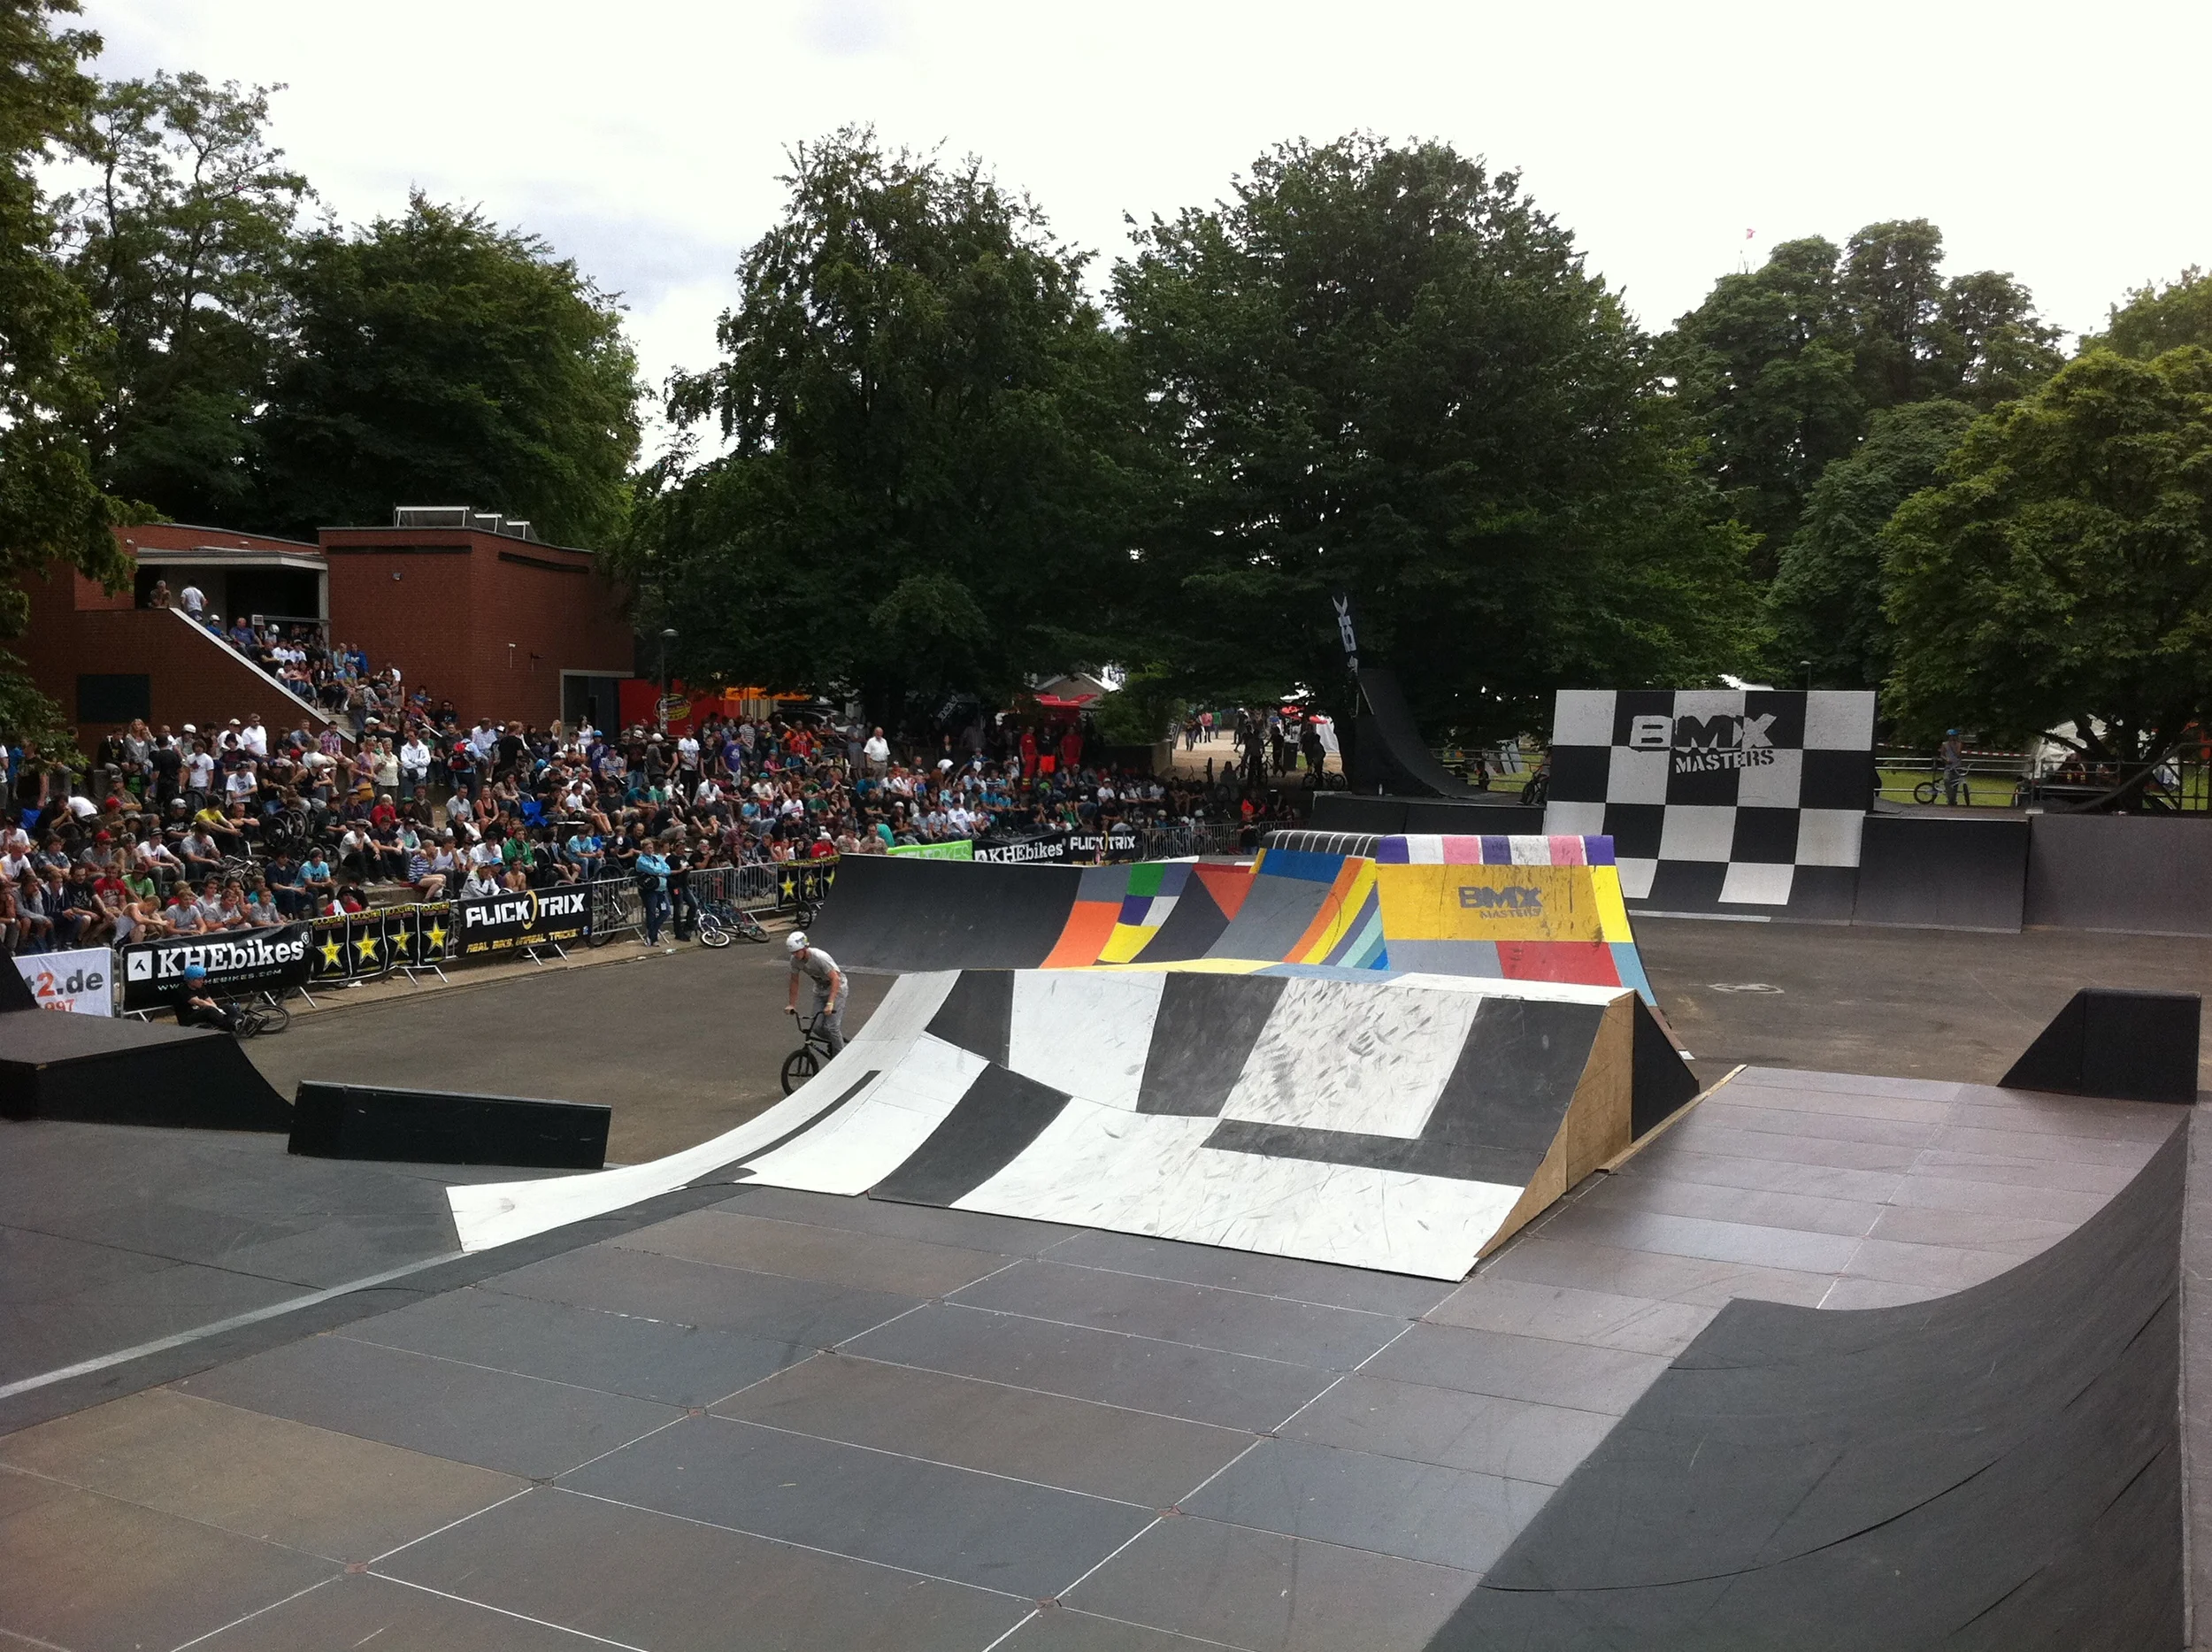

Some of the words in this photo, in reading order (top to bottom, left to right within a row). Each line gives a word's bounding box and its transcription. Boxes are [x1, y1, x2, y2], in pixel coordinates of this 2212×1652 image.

[1629, 713, 1777, 753] BMX
[1675, 750, 1775, 774] MASTERS
[988, 841, 1064, 863] KHEbikes
[1458, 887, 1543, 909] BMX
[1479, 907, 1541, 920] MASTERS
[157, 939, 304, 979] KHEbikes
